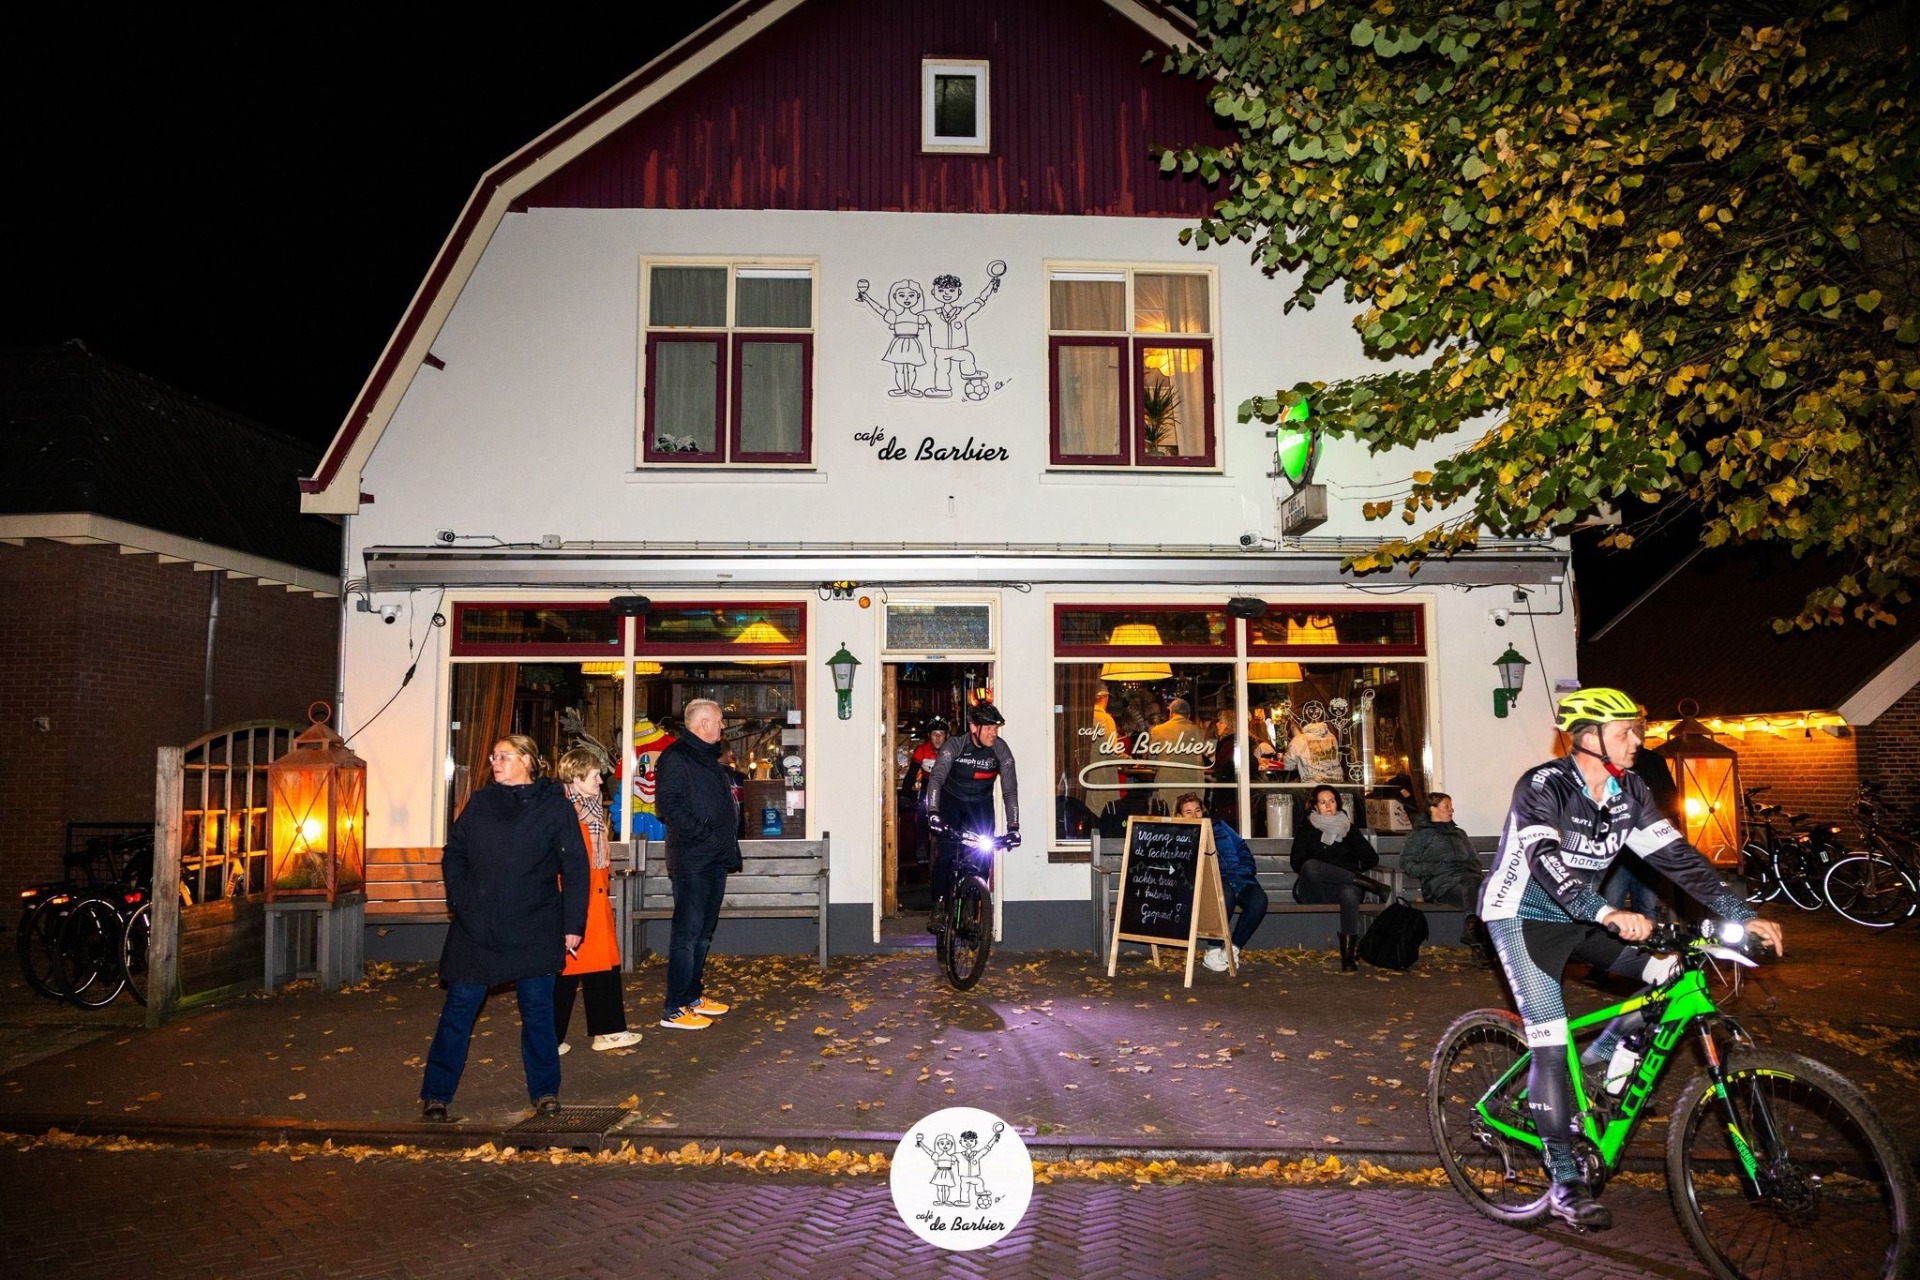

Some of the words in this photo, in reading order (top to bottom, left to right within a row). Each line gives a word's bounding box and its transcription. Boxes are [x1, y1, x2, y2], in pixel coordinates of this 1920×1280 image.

[854, 426, 884, 446] café
[878, 436, 907, 461] de
[914, 436, 1009, 461] Barbier
[1078, 722, 1105, 741] café
[1100, 733, 1125, 755] de
[1132, 731, 1215, 756] Barbier
[1548, 855, 1570, 879] BORA
[1621, 1024, 1675, 1117] CUBE
